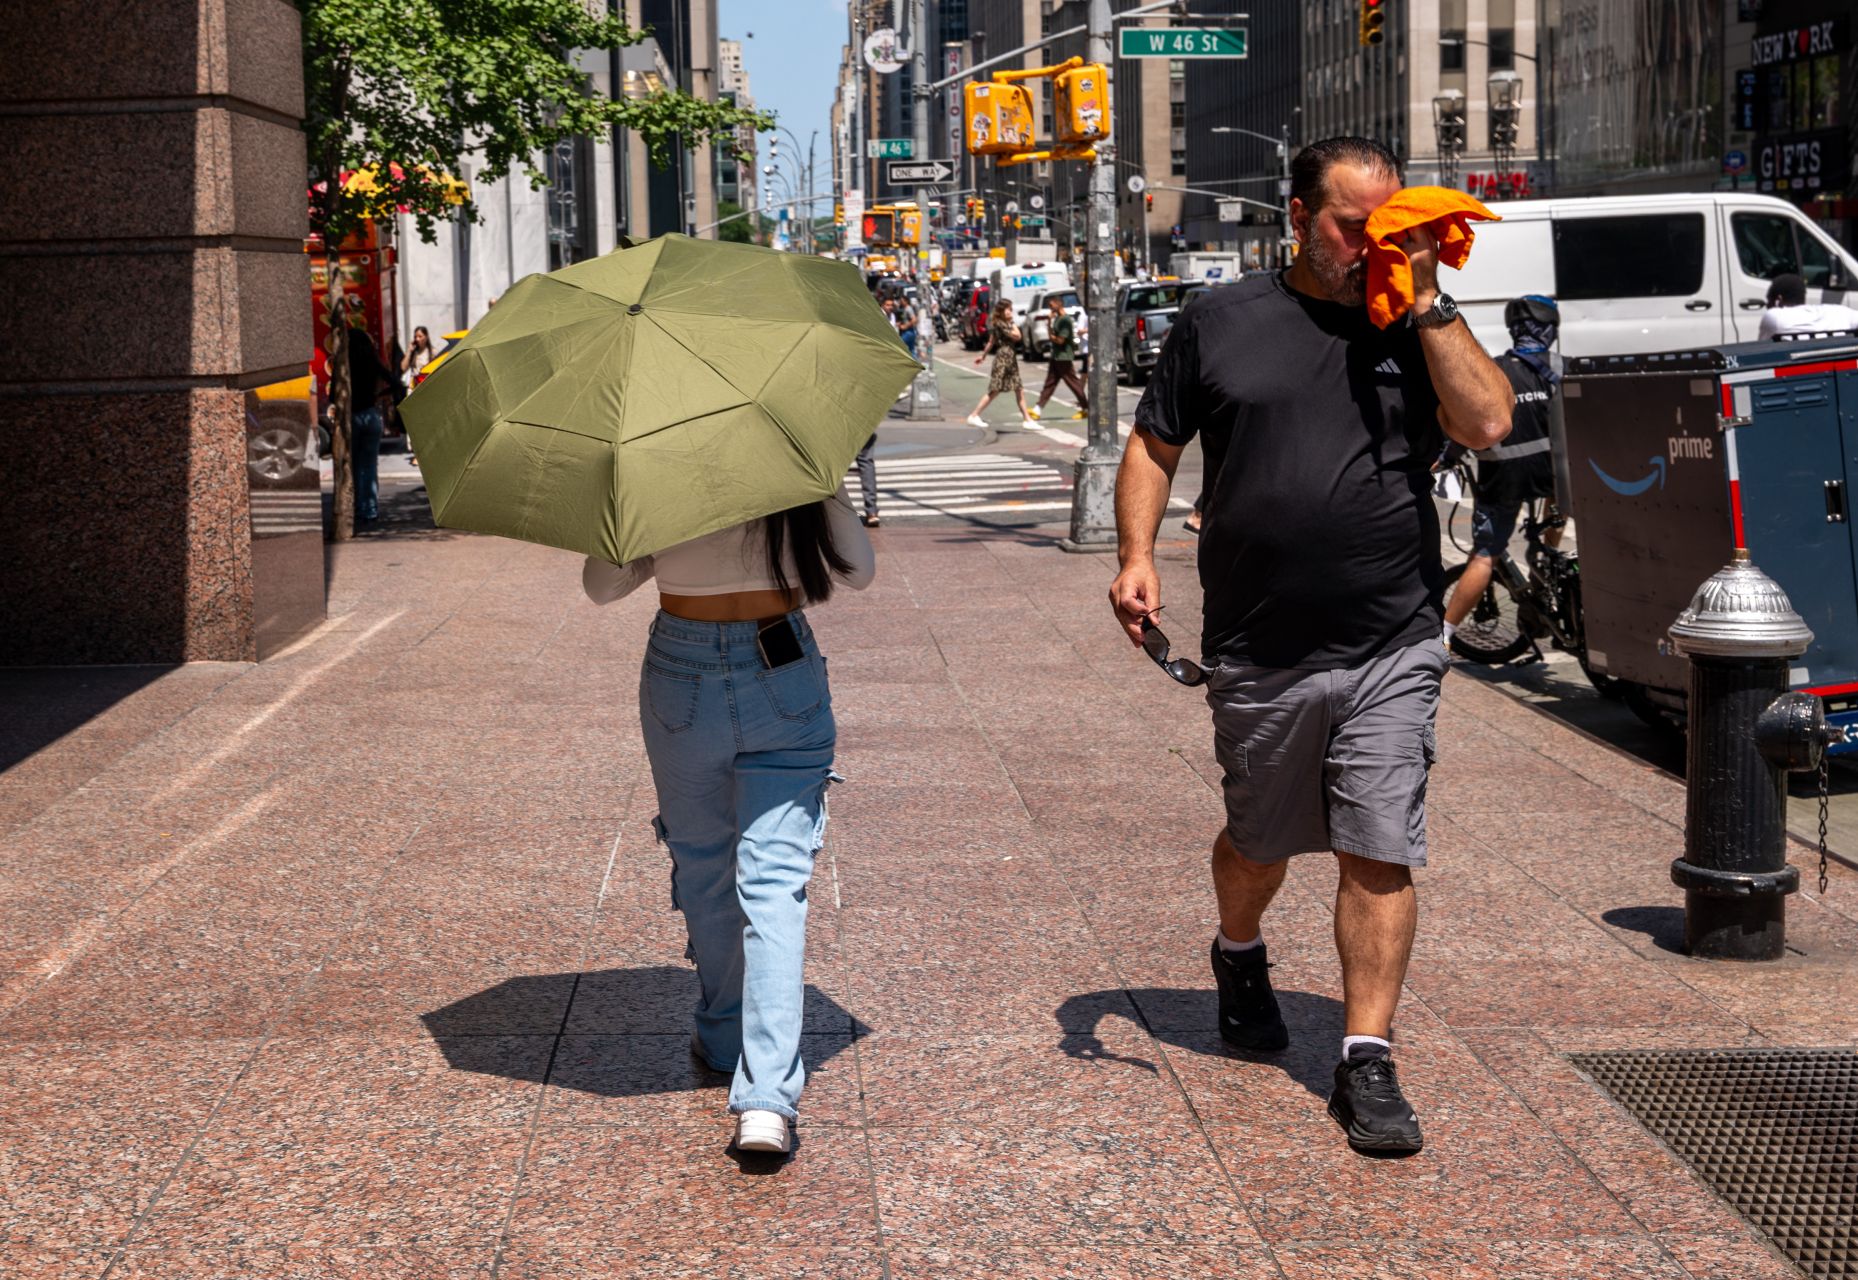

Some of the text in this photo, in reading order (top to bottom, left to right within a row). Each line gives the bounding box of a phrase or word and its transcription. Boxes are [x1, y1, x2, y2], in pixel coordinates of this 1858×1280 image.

[1149, 34, 1219, 52] W 46 St
[1752, 32, 1785, 66] NEW
[949, 50, 961, 117] RADIO
[890, 141, 903, 156] 46
[895, 165, 941, 178] ONE WAY
[1668, 429, 1713, 465] prime
